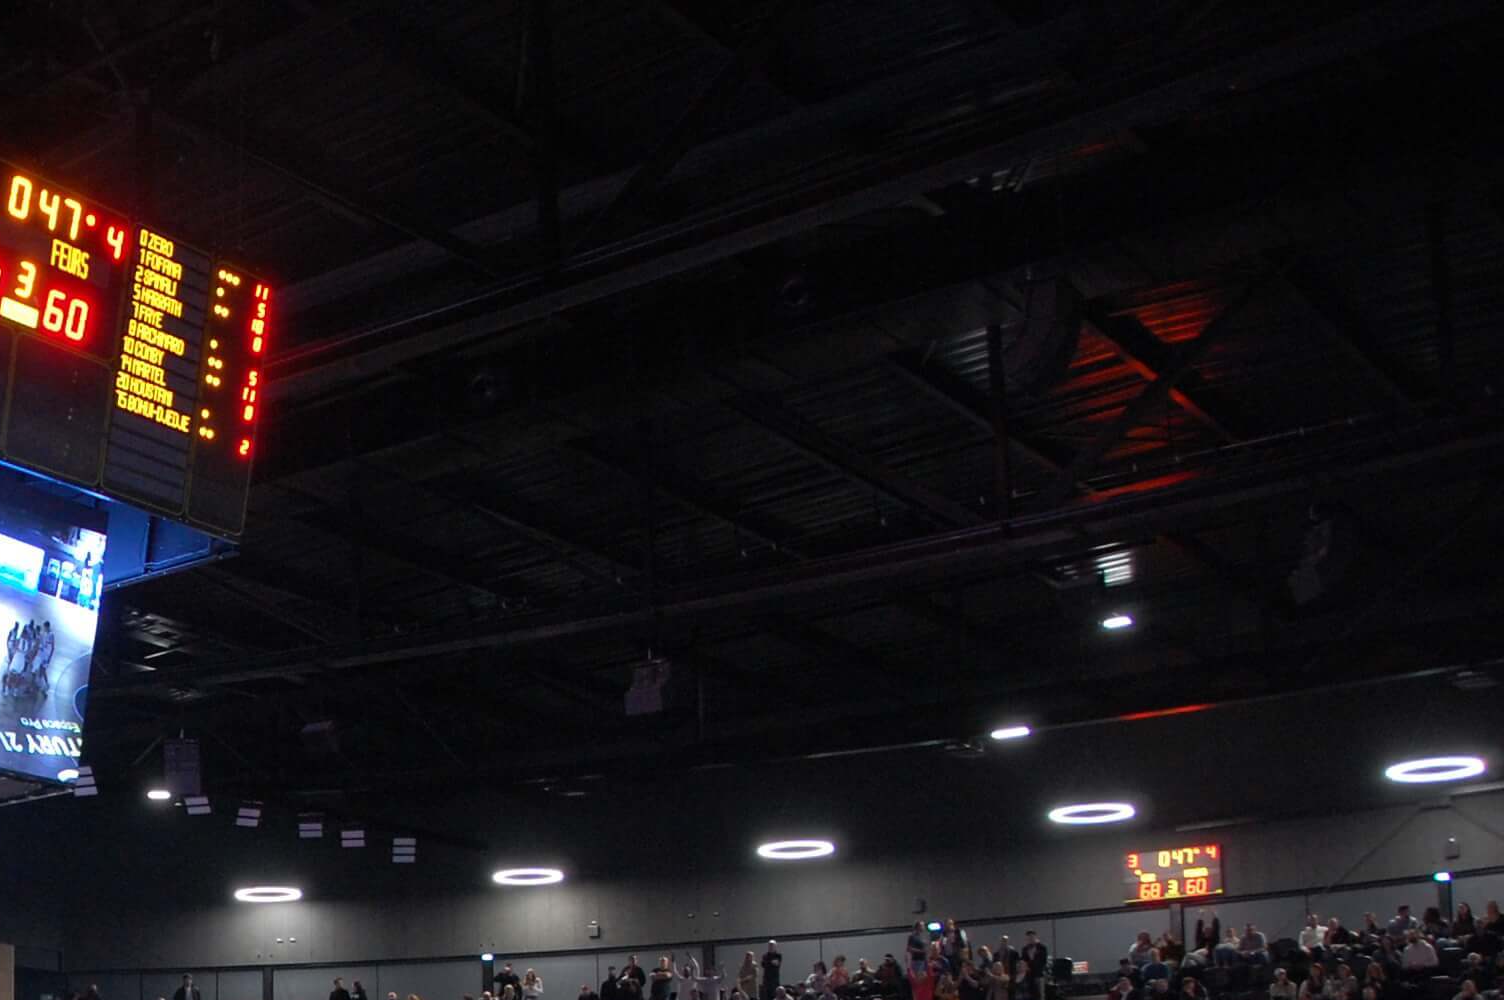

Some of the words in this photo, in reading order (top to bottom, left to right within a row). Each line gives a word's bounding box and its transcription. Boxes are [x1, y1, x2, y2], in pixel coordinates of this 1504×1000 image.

[106, 226, 124, 260] 4
[140, 229, 149, 246] 0
[148, 233, 173, 257] ZERO
[50, 238, 90, 280] FEURS
[140, 248, 145, 264] 1
[135, 265, 144, 282] 2
[133, 283, 141, 300] 5
[254, 285, 269, 301] 11
[13, 260, 37, 299] 3
[42, 289, 89, 342] 60
[132, 301, 139, 318] 7
[256, 302, 266, 319] 5
[128, 319, 137, 338] 8
[124, 336, 135, 354] 10
[121, 354, 133, 372] 14
[116, 371, 131, 390] 20
[249, 370, 257, 387] 5
[242, 387, 256, 403] 11
[240, 440, 249, 456] 2
[1127, 854, 1139, 868] 3
[1206, 846, 1216, 858] 4
[1139, 882, 1162, 899] 68
[1185, 878, 1208, 895] 60
